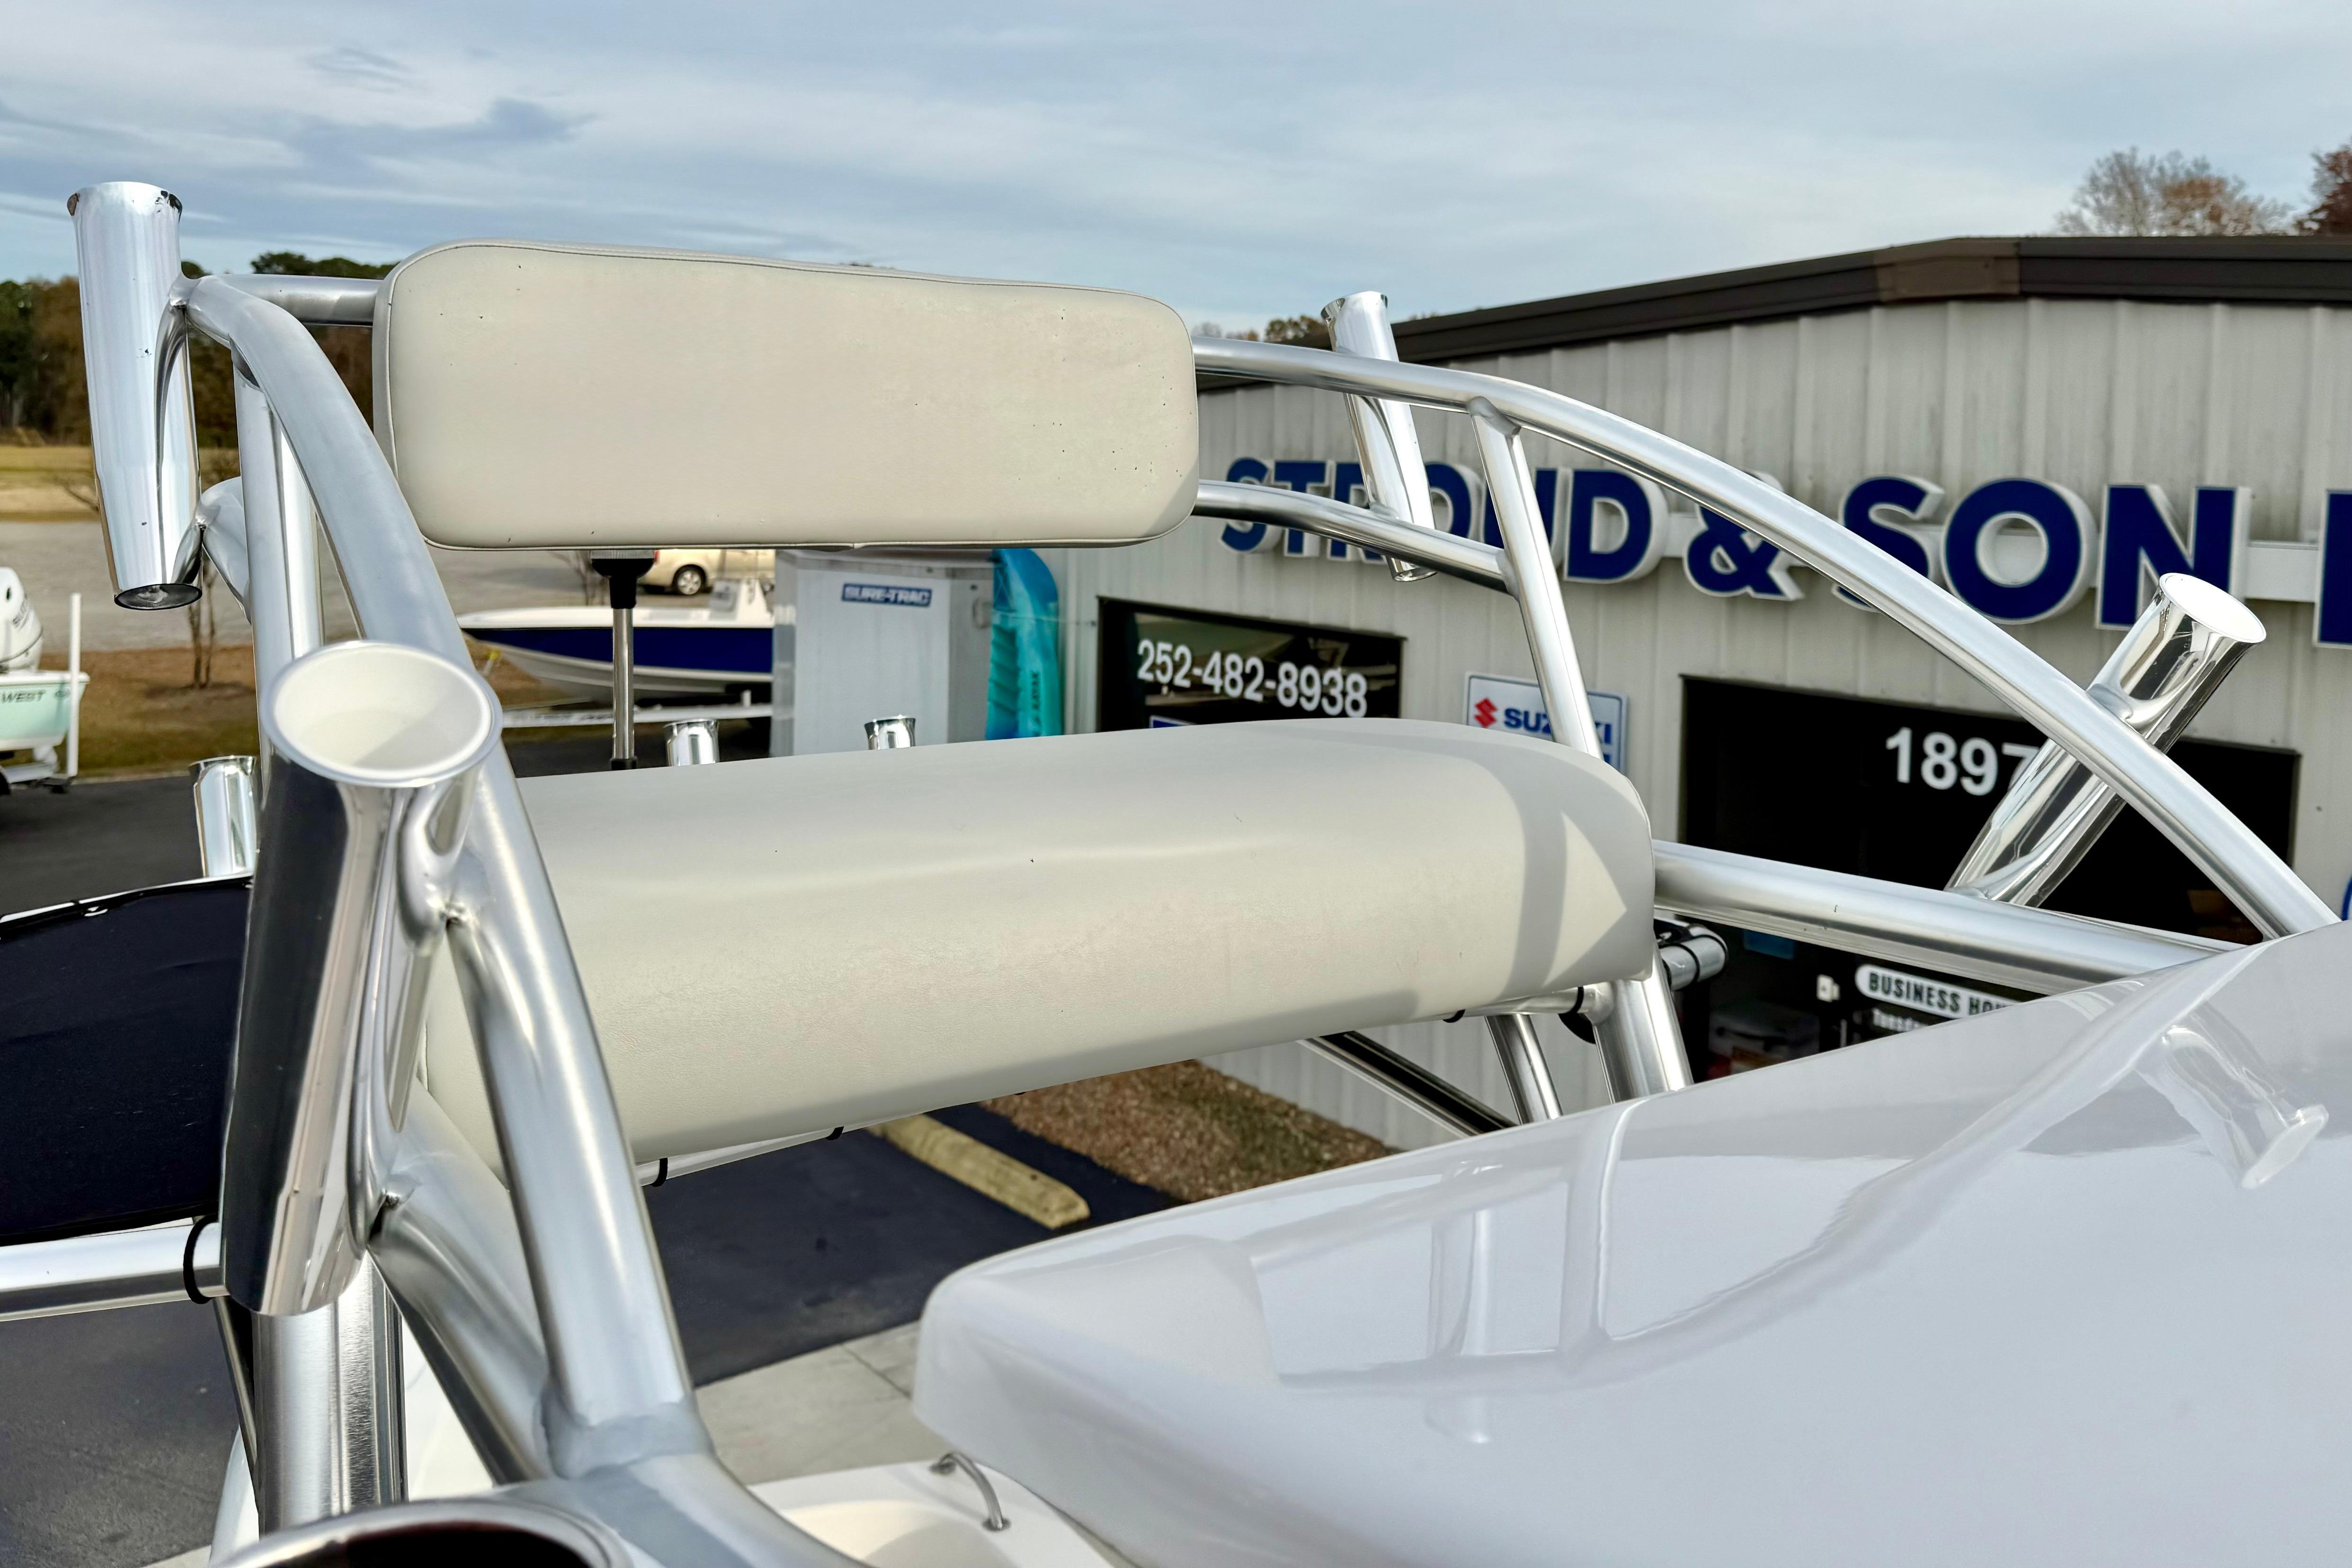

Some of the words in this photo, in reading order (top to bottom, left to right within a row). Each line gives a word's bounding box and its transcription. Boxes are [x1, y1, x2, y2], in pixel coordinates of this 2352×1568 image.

[1684, 473, 1792, 598] &
[1834, 475, 2236, 628] SON
[1137, 639, 1368, 719] 252-482-8938
[1869, 972, 1960, 1013] BUSINESS
